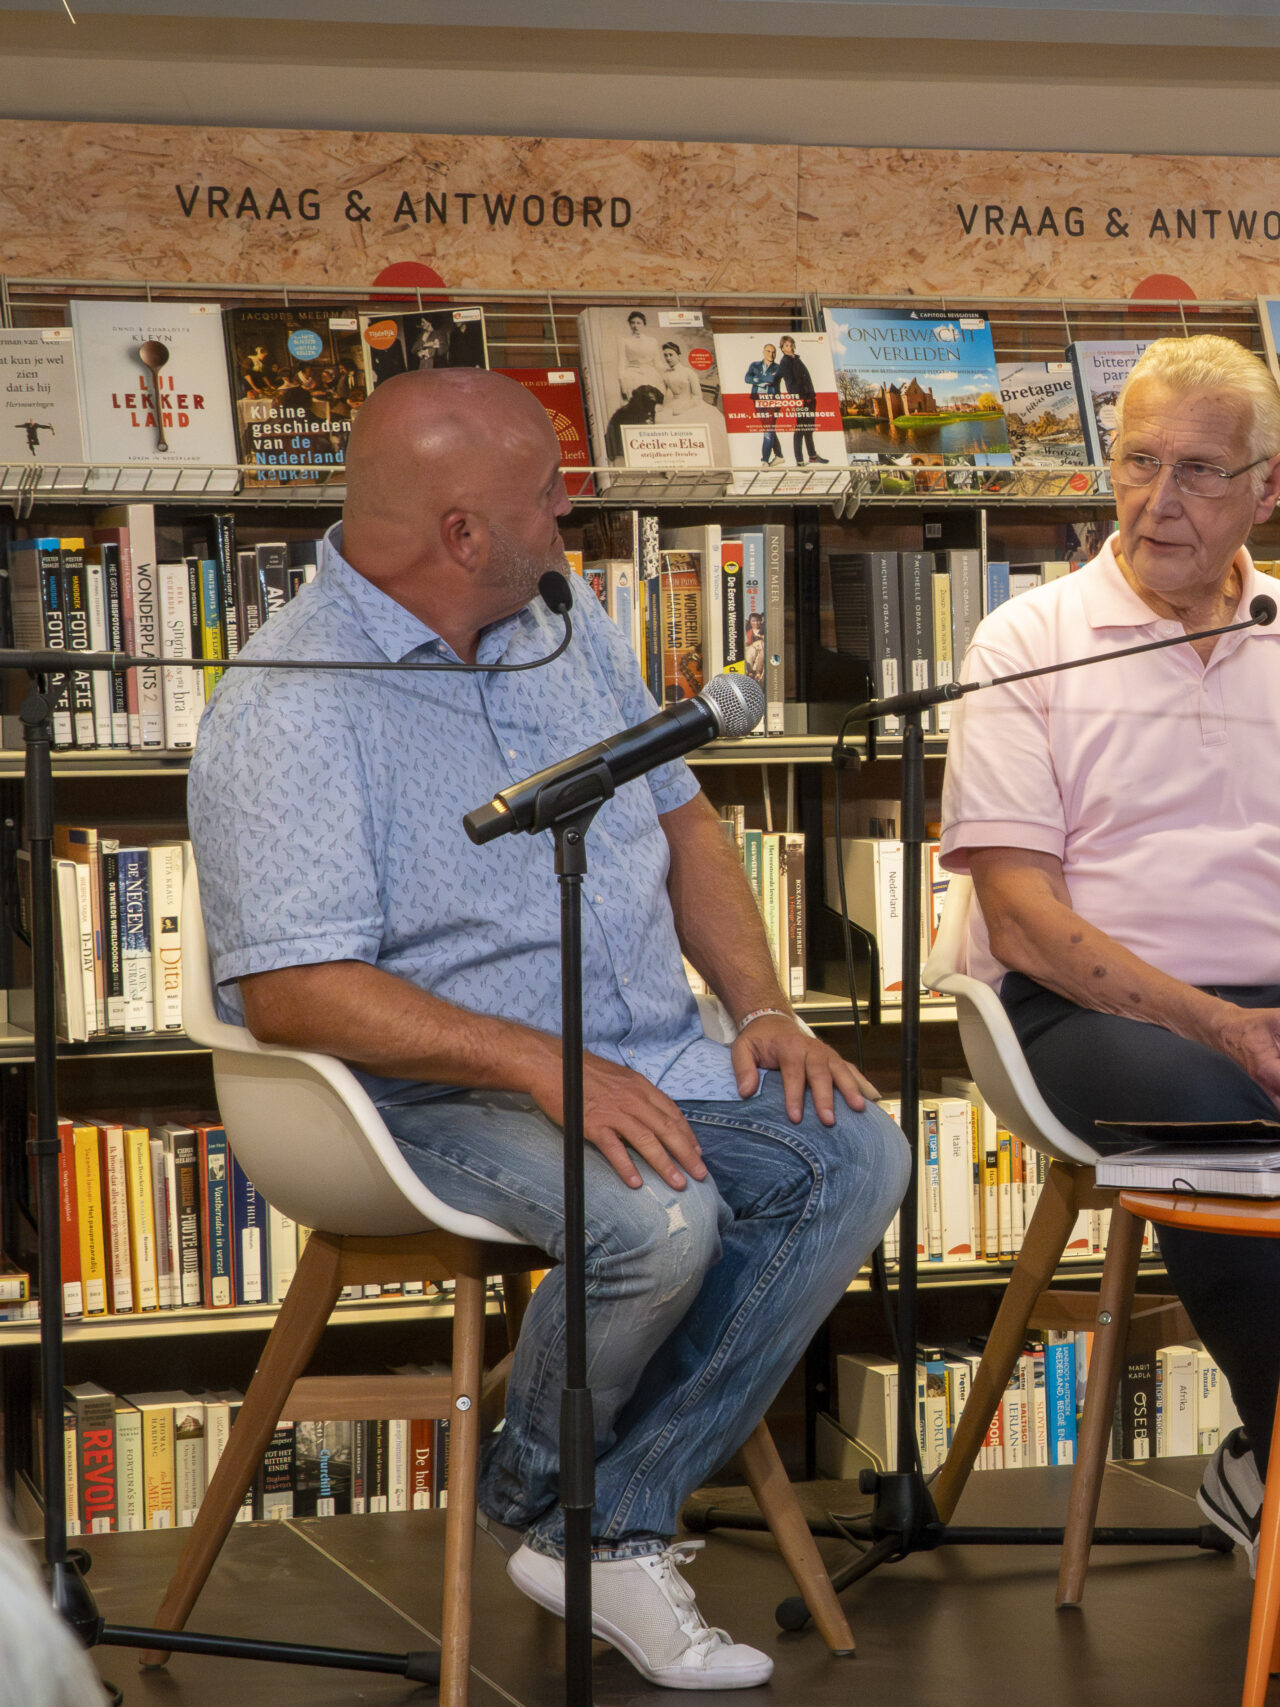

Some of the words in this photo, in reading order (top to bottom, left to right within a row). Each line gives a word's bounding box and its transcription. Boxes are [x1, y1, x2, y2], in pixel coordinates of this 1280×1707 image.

[176, 185, 322, 222] VRAAG
[345, 190, 372, 223] &
[394, 192, 633, 229] ANTWOORD
[957, 204, 1085, 240] VRAAG
[1106, 207, 1131, 240] &
[241, 311, 294, 321] JACQUES
[132, 334, 173, 343] KLEYN
[847, 326, 976, 344] ONVERWACHT
[11, 355, 31, 365] kun
[34, 356, 43, 368] je
[47, 355, 64, 365] wel
[869, 346, 961, 362] VERLEDEN
[16, 370, 38, 379] zien
[6, 383, 23, 393] dat
[25, 383, 34, 393] is
[37, 382, 51, 395] hij
[1000, 378, 1073, 403] Bretagne
[111, 393, 206, 410] LEKKER
[251, 405, 306, 420] Kleine
[131, 411, 190, 428] LAND
[252, 420, 351, 437] geschieden
[254, 438, 283, 450] van
[291, 436, 311, 449] de
[630, 437, 667, 450] Cécile
[680, 438, 705, 450] Elsa
[255, 449, 344, 466] Nederland
[770, 535, 780, 573] NOOIT
[109, 563, 117, 577] HET
[727, 576, 736, 587] De
[880, 558, 889, 600] MICHELLE
[913, 559, 921, 602] MICHELLE
[962, 554, 970, 587] BARACK
[72, 575, 80, 609] HANDBOEK
[110, 577, 119, 598] GROTE
[727, 587, 737, 611] Eerste
[770, 574, 780, 603] MEER
[226, 606, 236, 624] THE
[666, 593, 682, 619] MAAR
[137, 563, 157, 689] WONDERPLANTS
[683, 593, 699, 649] WONDERLIJK
[882, 603, 890, 635] OBAMA
[914, 604, 923, 636] OBAMA
[227, 624, 238, 660] ROLLING
[666, 620, 682, 649] WAAR
[726, 612, 739, 662] Wereldoorlog
[70, 611, 92, 708] FOTOAFIE
[115, 677, 124, 698] SCOTT
[143, 693, 157, 703] 2
[127, 863, 140, 878] DE
[164, 855, 174, 876] DITA
[109, 881, 117, 891] DE
[165, 878, 174, 905] KRAUS
[888, 871, 898, 918] Nederland
[110, 891, 118, 919] TWEEDE
[125, 878, 144, 935] NEGEN
[82, 932, 93, 973] D-DAY
[110, 919, 120, 973] WERELDOORLOG
[159, 947, 182, 991] Dita
[109, 1146, 117, 1154] Ik
[930, 1136, 938, 1160] TOP10
[952, 1134, 961, 1158] Italië
[109, 1155, 119, 1174] hoop
[110, 1174, 119, 1187] dat
[111, 1187, 120, 1205] alles
[87, 1205, 95, 1219] Het
[213, 1185, 225, 1236] Vastberaden
[181, 1213, 198, 1248] FOUTE
[215, 1238, 224, 1248] in
[215, 1249, 226, 1275] verzet
[1055, 1347, 1064, 1398] NEDERLAND,
[958, 1372, 967, 1401] Trotter
[1178, 1384, 1188, 1412] Afrika
[1064, 1382, 1072, 1416] AUTOBOEK
[1057, 1400, 1066, 1426] BELGIË
[1057, 1428, 1065, 1441] EN
[264, 1456, 292, 1464] BITTERE
[278, 1449, 293, 1457] HET
[415, 1448, 429, 1466] De
[126, 1448, 136, 1500] FORTUNA'S
[268, 1463, 289, 1472] EINDE
[319, 1448, 331, 1497] Churchill
